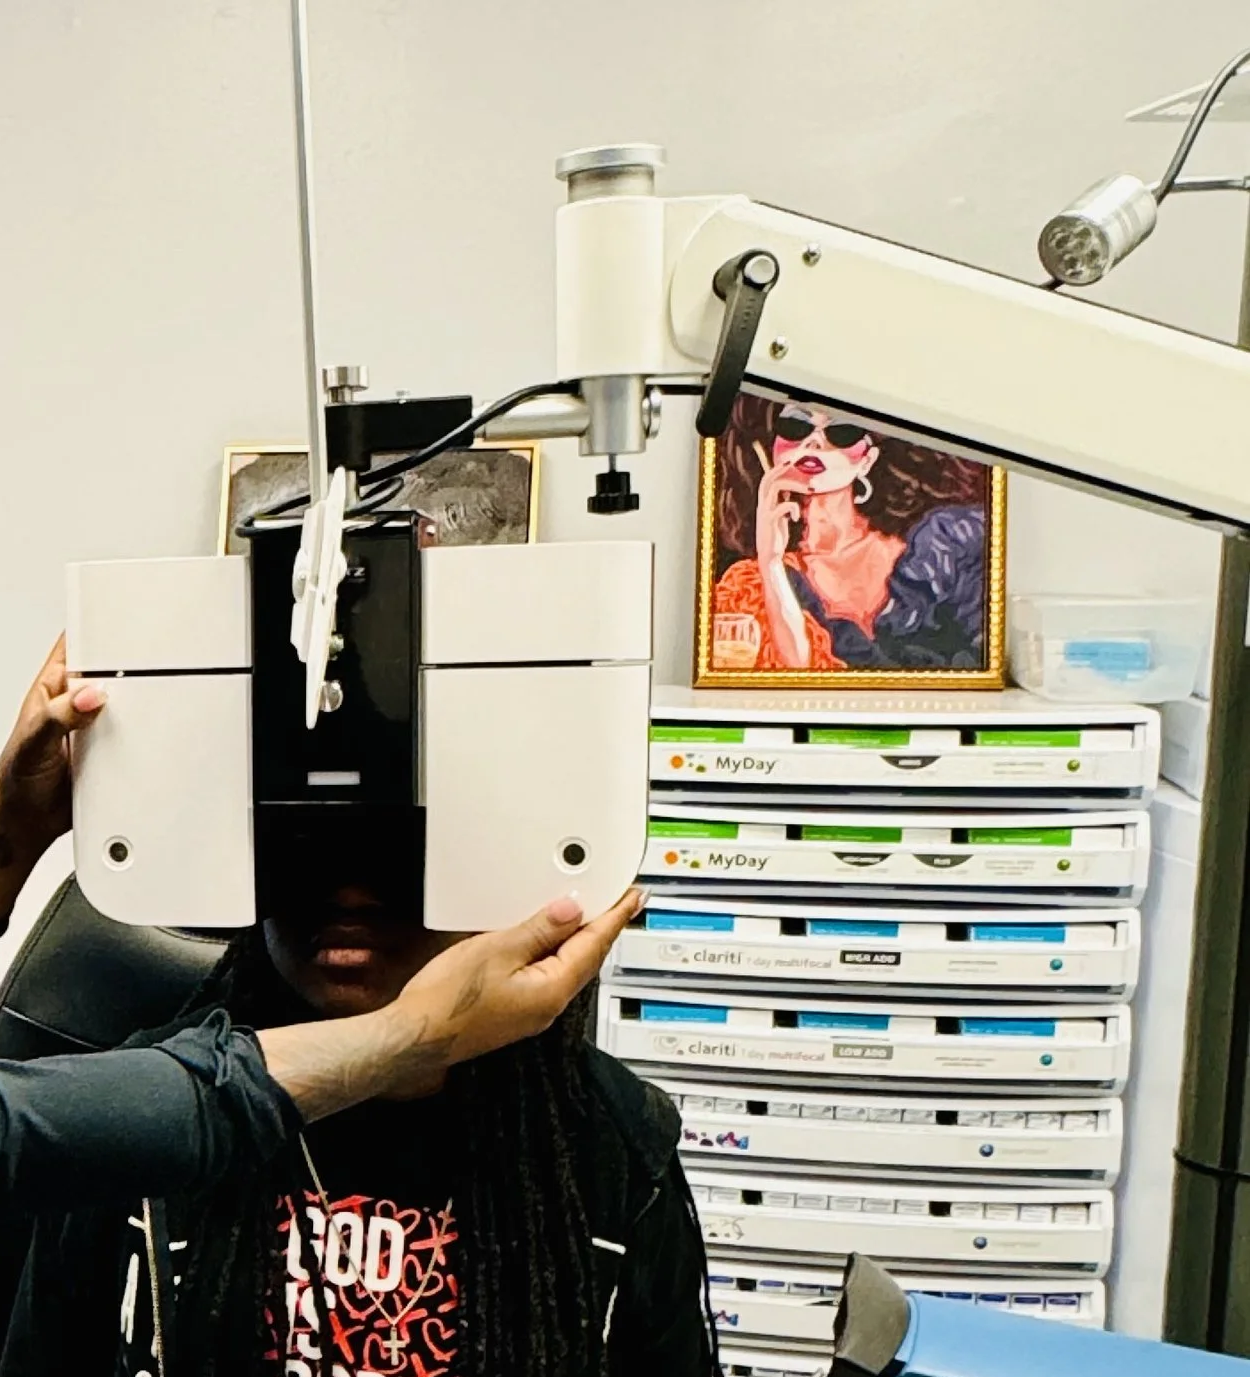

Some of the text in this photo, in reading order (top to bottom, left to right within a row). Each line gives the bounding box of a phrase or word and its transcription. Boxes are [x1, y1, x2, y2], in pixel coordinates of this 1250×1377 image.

[715, 756, 776, 775] MyDay
[708, 852, 768, 871] MyDay
[693, 949, 742, 965] clariti
[688, 1041, 736, 1057] clariti
[287, 1206, 405, 1292] GOD
